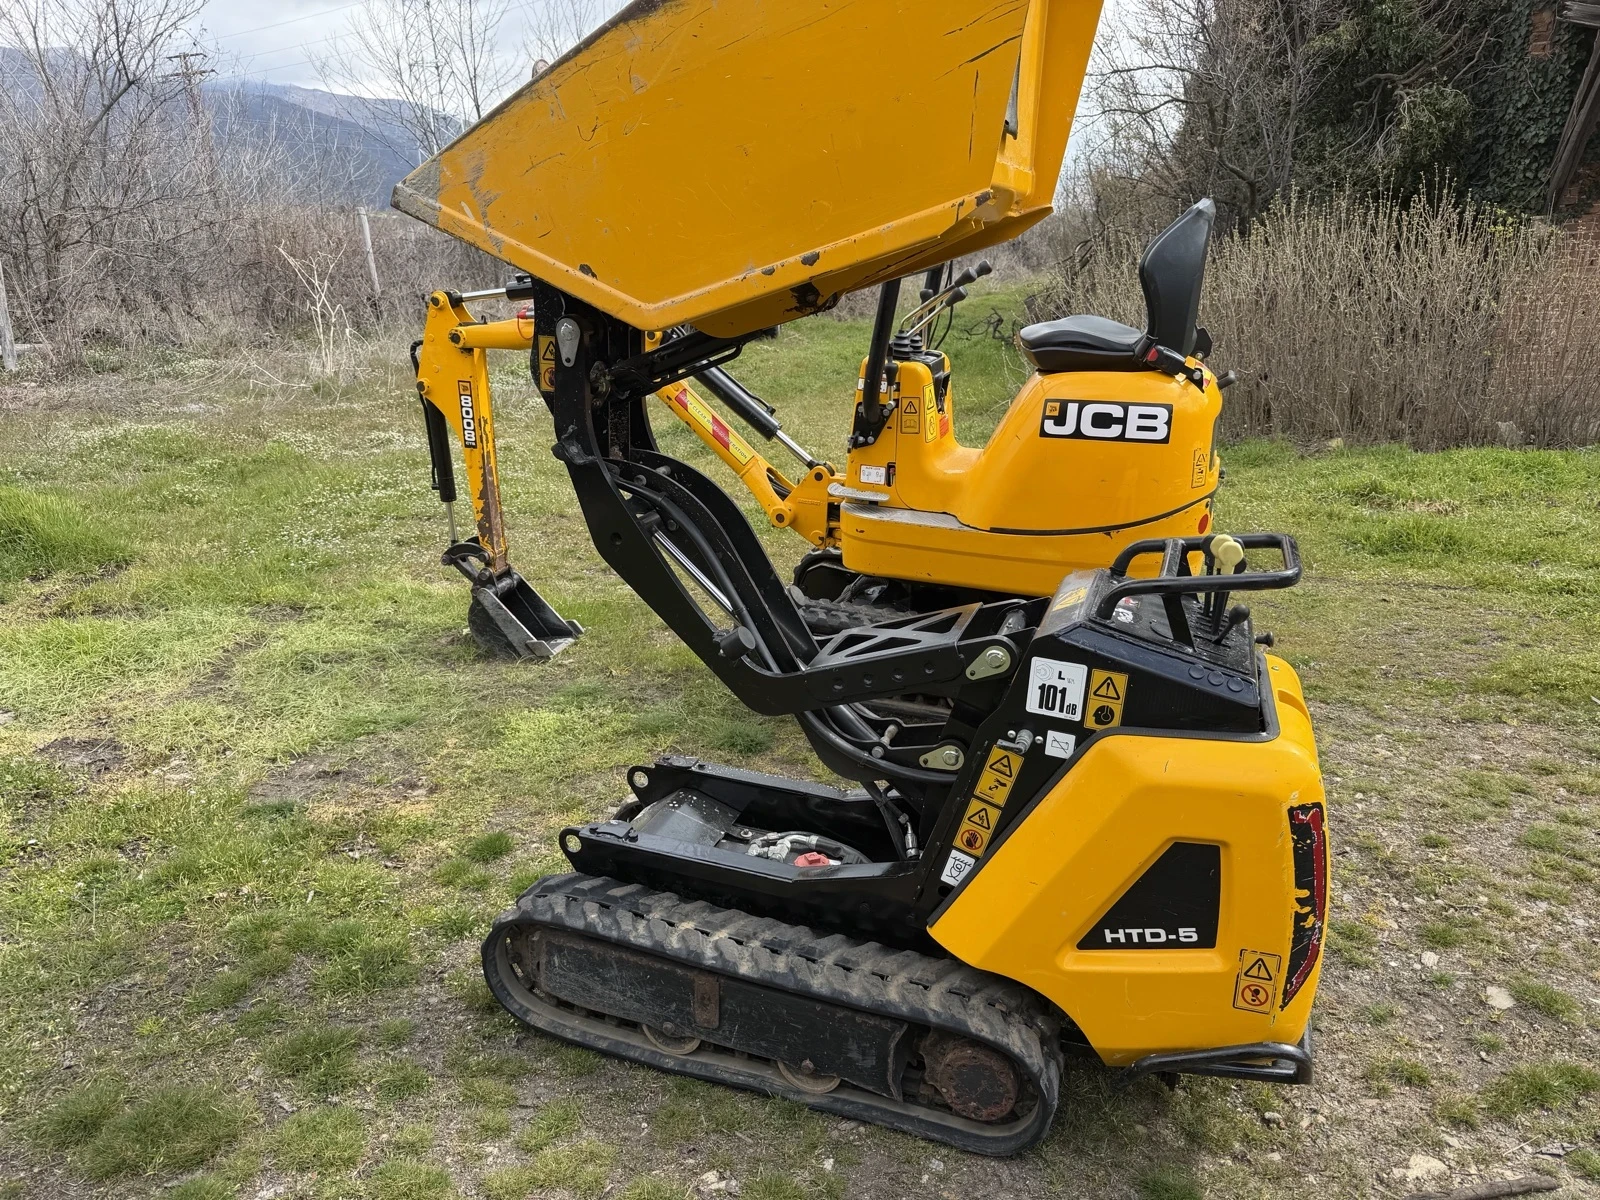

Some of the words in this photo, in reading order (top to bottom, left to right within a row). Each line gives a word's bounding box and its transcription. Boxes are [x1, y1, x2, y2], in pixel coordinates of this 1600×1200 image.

[461, 396, 475, 441] 8008
[1043, 402, 1169, 440] JCB
[1058, 671, 1065, 680] L
[1038, 683, 1067, 713] 101
[1066, 703, 1077, 715] dB
[1104, 928, 1198, 943] HTD-5
